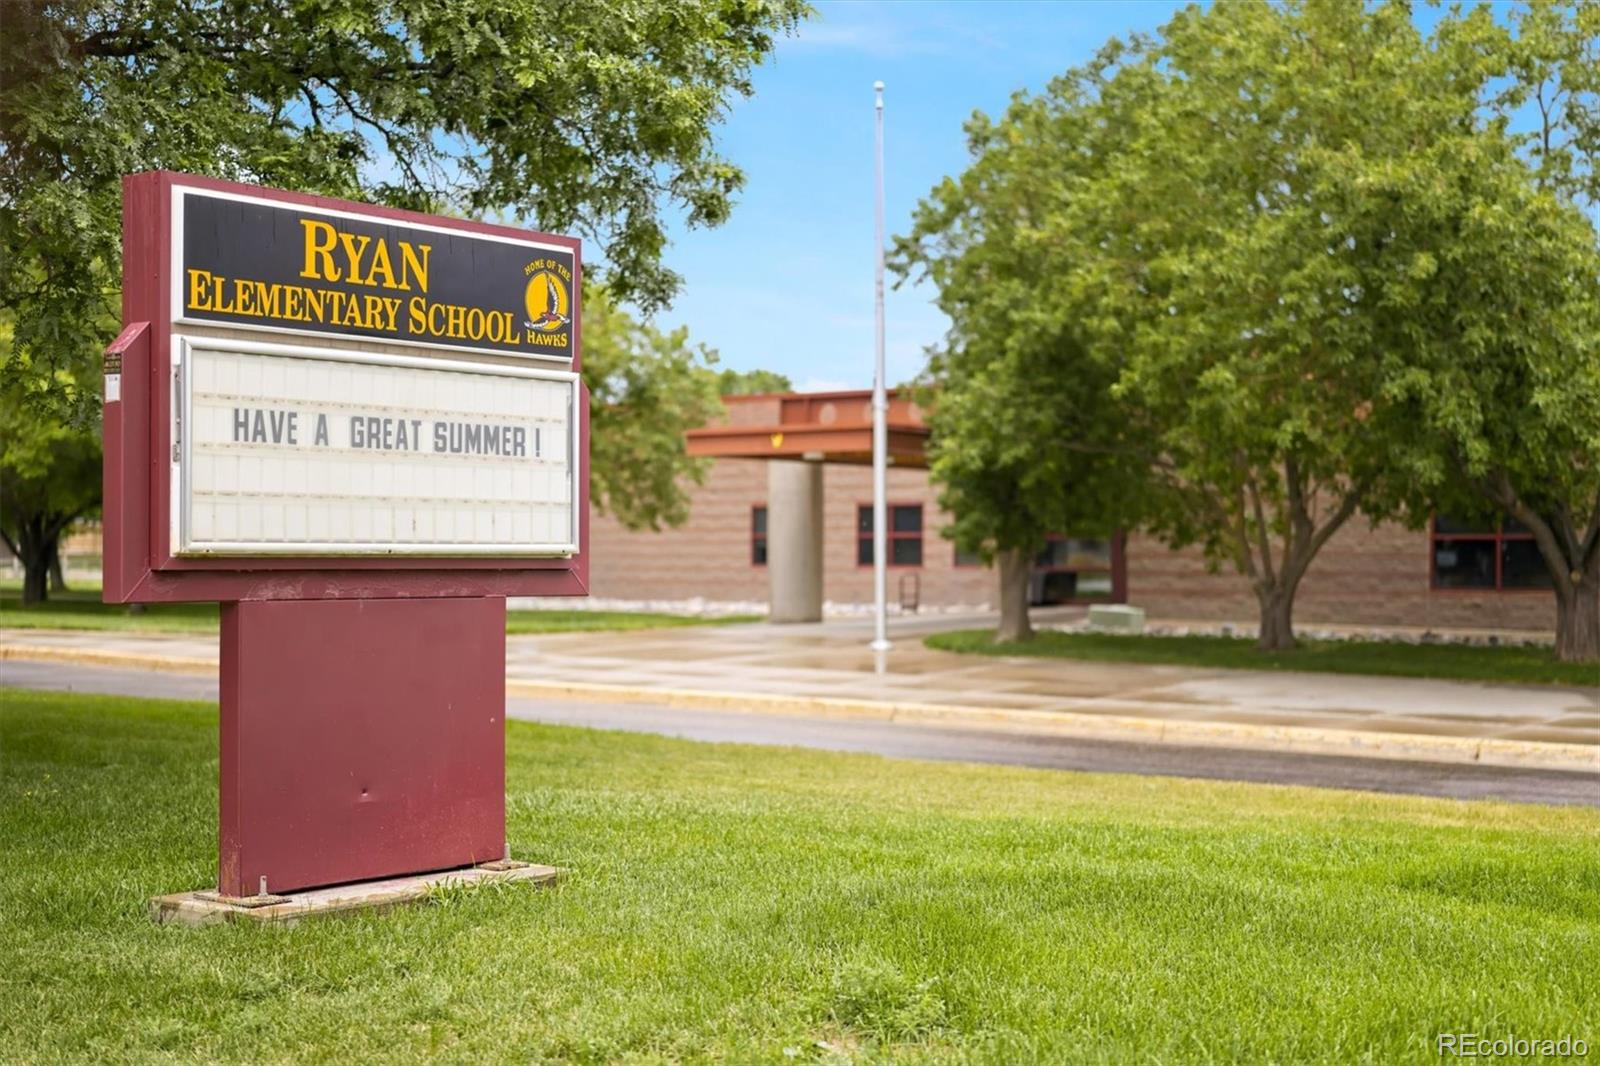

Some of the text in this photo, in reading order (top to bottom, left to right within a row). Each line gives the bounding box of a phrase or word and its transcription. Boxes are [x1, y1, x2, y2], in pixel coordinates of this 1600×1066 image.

[300, 219, 432, 293] RYAN
[524, 259, 571, 281] HOME OF THE
[187, 268, 520, 345] ELEMENTARY SCHOOL
[527, 330, 568, 348] HAWKS
[233, 408, 298, 445] HAVE
[314, 413, 329, 446] A
[350, 416, 422, 451] GREAT
